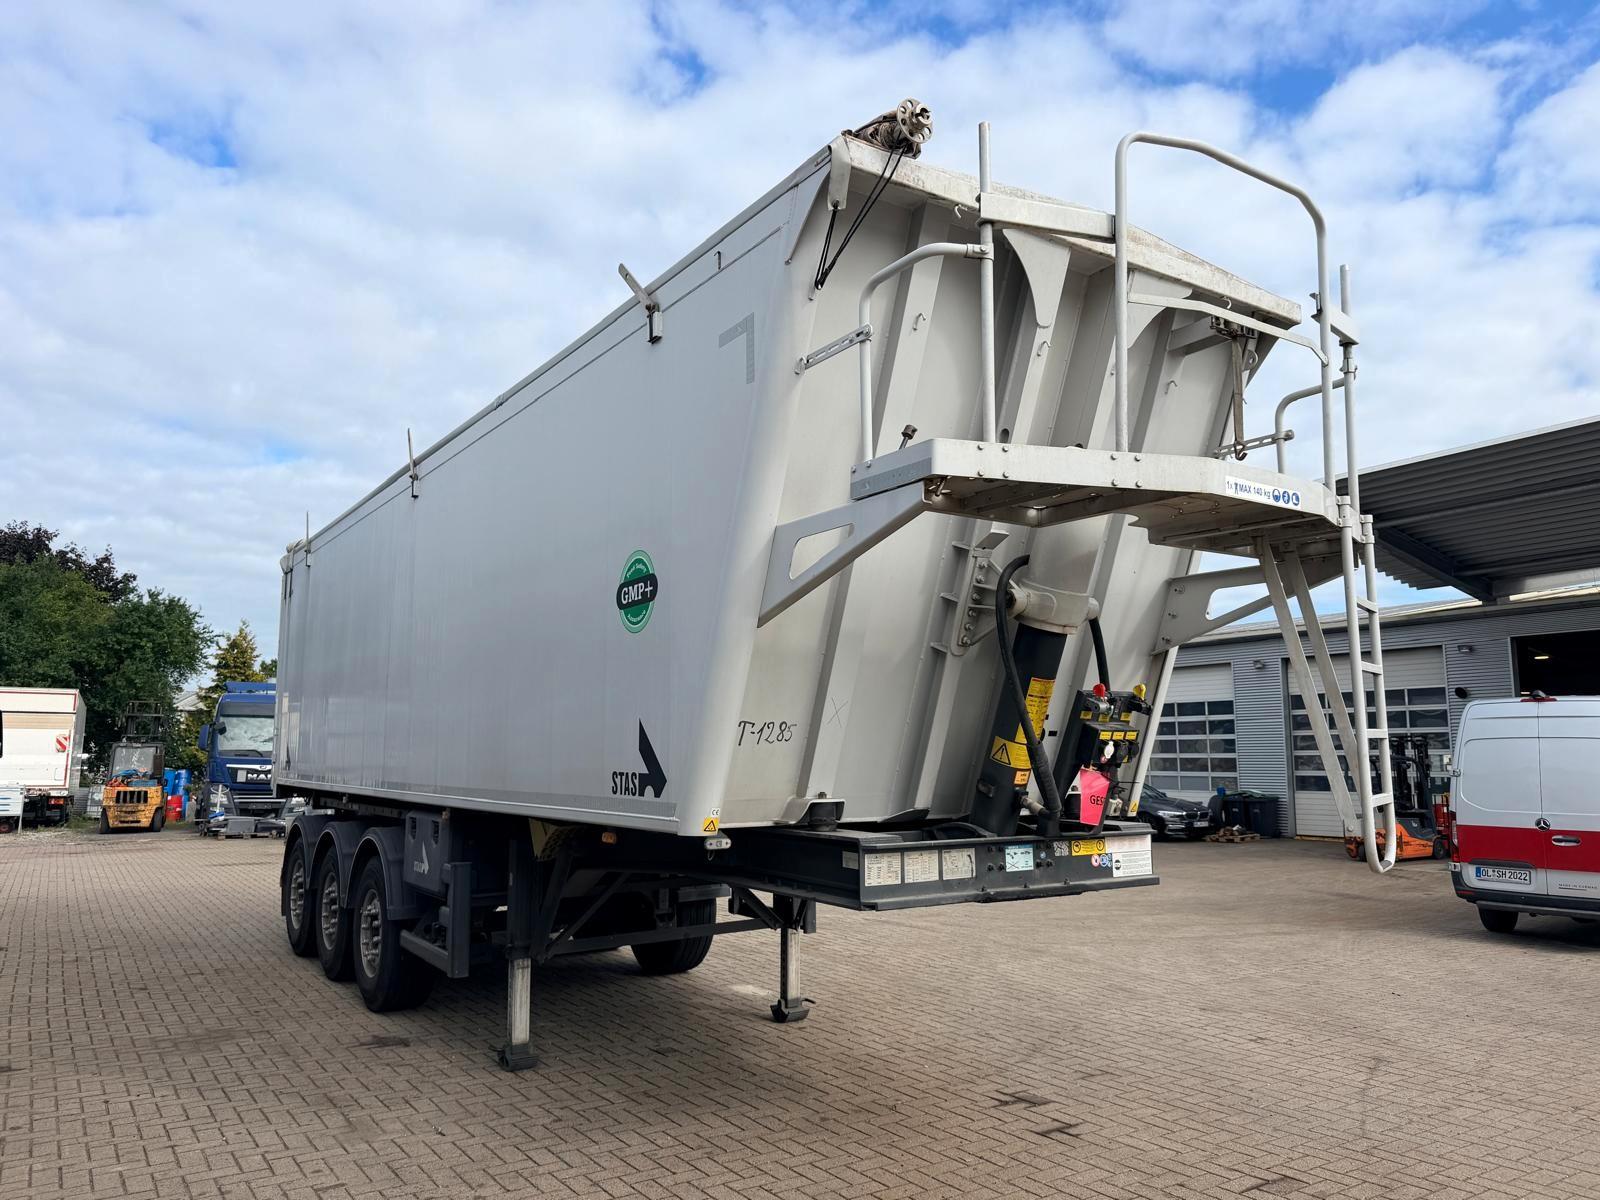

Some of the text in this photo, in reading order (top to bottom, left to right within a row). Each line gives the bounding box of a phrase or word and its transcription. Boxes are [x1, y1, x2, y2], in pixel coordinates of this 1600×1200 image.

[1239, 483, 1252, 494] MAX
[1253, 486, 1263, 496] 140
[1264, 488, 1271, 500] kg
[621, 580, 654, 605] GMP+
[738, 720, 798, 746] T-1285
[611, 771, 638, 797] STAS
[1089, 794, 1106, 806] GES
[1481, 868, 1528, 881] OL SH 2022
